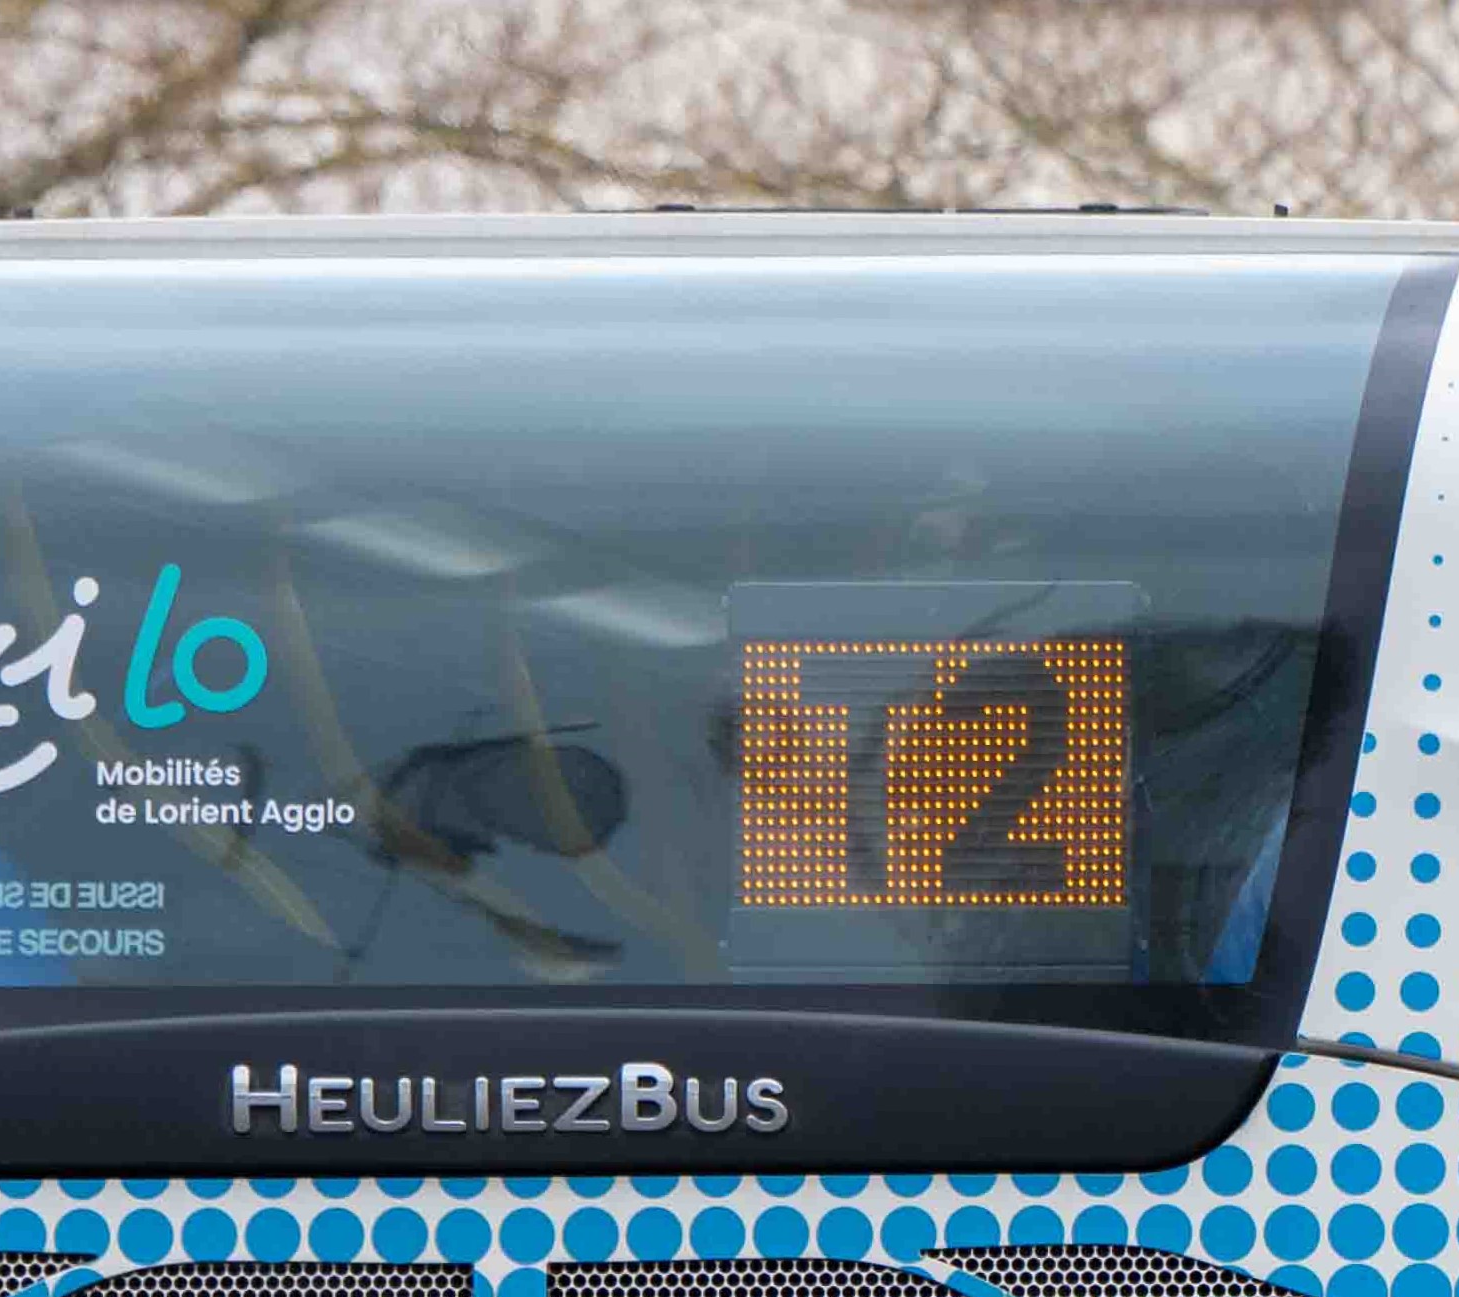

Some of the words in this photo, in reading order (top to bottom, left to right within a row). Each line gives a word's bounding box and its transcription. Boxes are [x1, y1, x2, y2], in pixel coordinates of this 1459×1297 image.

[124, 563, 268, 729] lo
[96, 758, 241, 787] Mobilités
[797, 650, 1071, 896] T2
[95, 798, 137, 825] de
[144, 797, 253, 825] Lorient
[261, 798, 355, 832] Agglo
[18, 929, 165, 956] SECOURS
